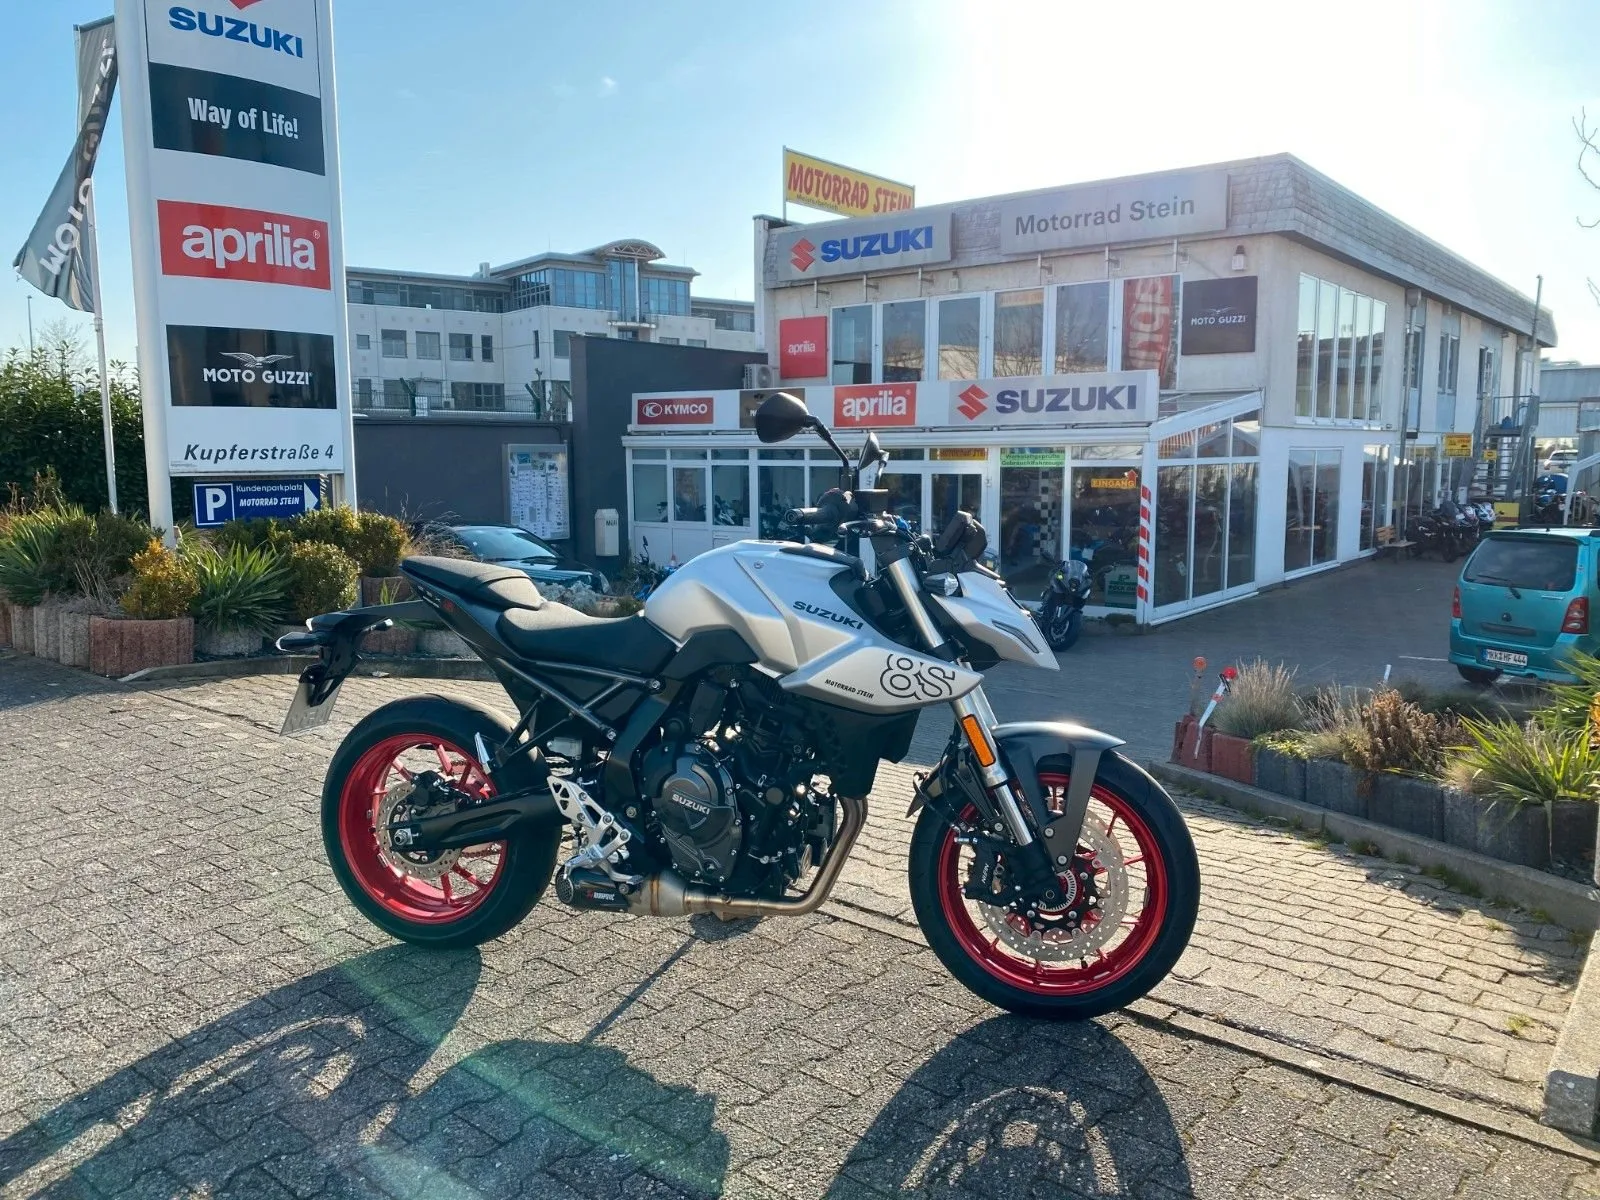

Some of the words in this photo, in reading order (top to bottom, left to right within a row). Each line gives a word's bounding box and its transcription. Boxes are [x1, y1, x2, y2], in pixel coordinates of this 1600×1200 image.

[168, 6, 303, 58] SUZUKI
[187, 97, 232, 129] Way
[238, 108, 258, 130] of
[262, 110, 299, 139] Life!
[787, 162, 870, 210] MOTORRAD
[873, 187, 912, 213] STEIN
[1015, 204, 1121, 235] Motorrad
[1129, 196, 1195, 221] Stein
[181, 221, 315, 271] aprilia
[821, 226, 933, 263] SUZUKI
[1191, 316, 1215, 326] MOTO
[1219, 314, 1246, 324] GUZZI
[788, 341, 815, 355] aprilia
[203, 367, 256, 383] MOTO
[262, 369, 310, 385] GUZZI
[664, 404, 707, 415] KYMCO
[842, 391, 907, 421] aprilia
[996, 385, 1137, 414] SUZUKI
[184, 444, 319, 464] Kupferstraße
[324, 445, 334, 459] 4
[236, 484, 303, 493] Kundenparkplatz
[1092, 479, 1135, 488] EINGANG
[205, 488, 227, 520] P
[240, 498, 278, 507] MOTORRAD
[280, 497, 300, 505] STEIN
[793, 600, 864, 630] SUZUKI
[825, 679, 856, 693] MOTORRAD
[857, 689, 874, 699] STEIN
[671, 793, 710, 815] SUZUKI
